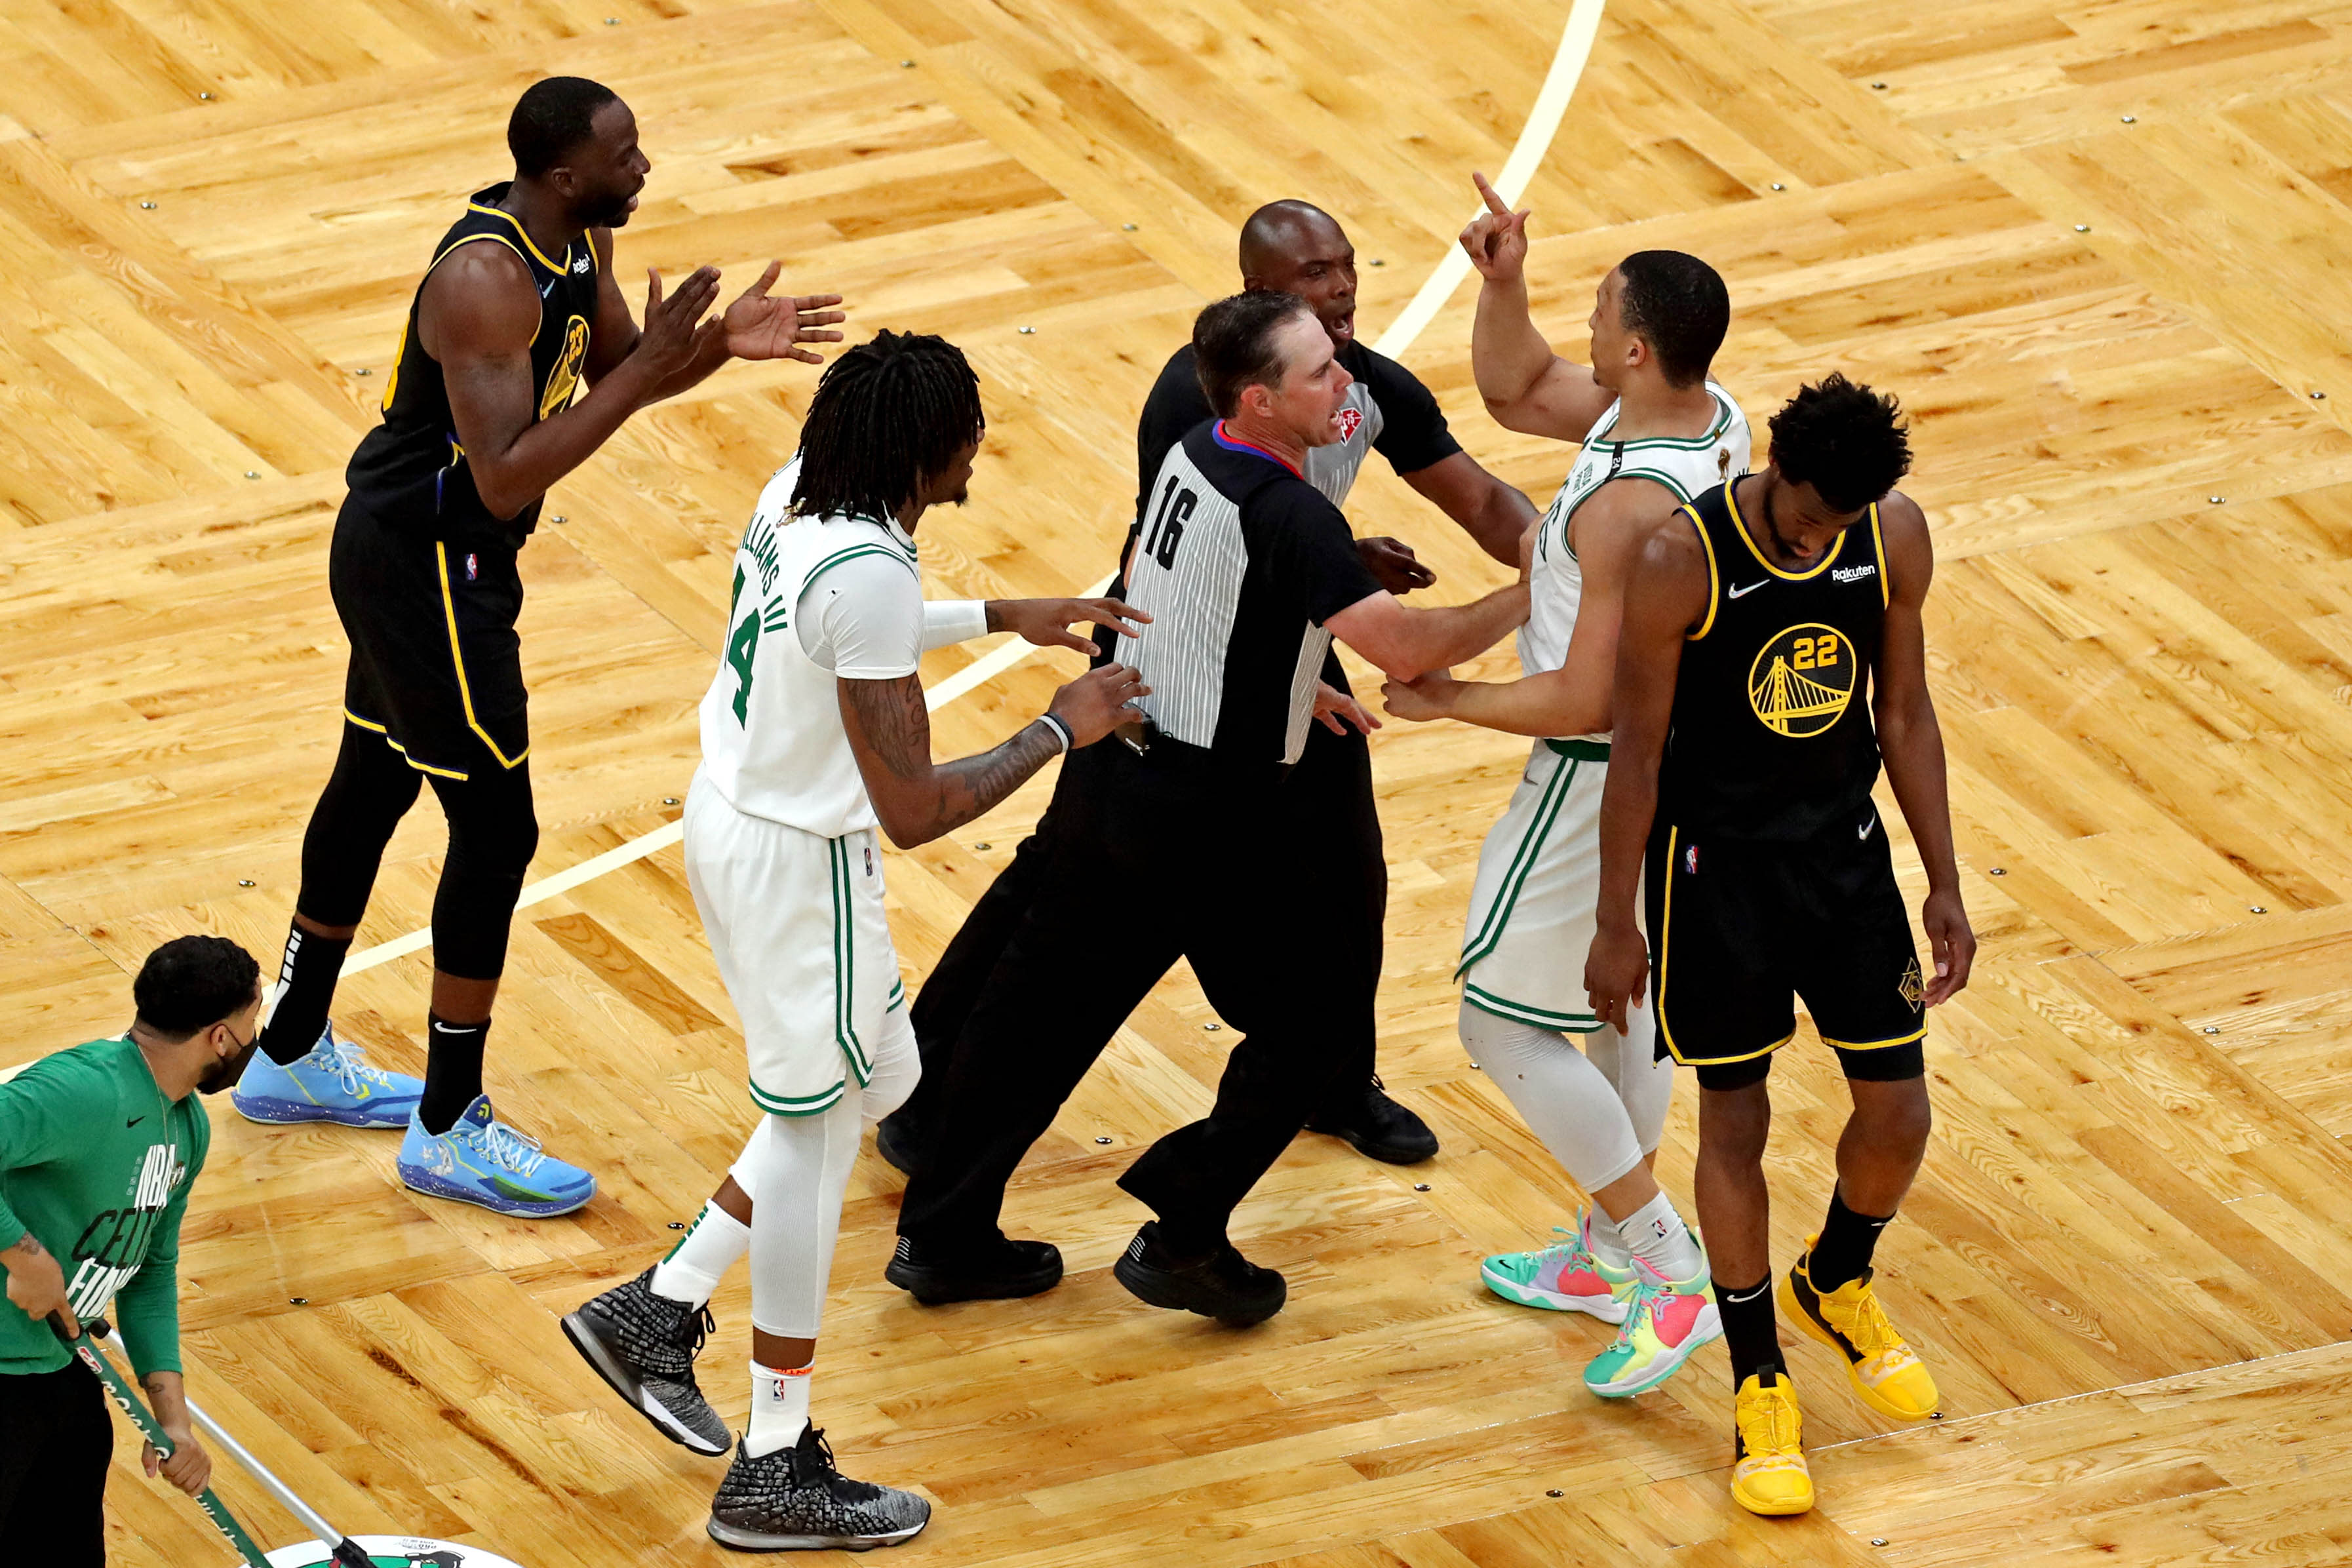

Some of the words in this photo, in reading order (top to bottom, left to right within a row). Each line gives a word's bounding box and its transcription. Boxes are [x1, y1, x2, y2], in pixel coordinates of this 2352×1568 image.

[568, 323, 583, 363] 23
[1613, 457, 1621, 469] 24
[1145, 475, 1198, 571] 16
[1832, 564, 1875, 581] Rakuten
[1793, 635, 1837, 670] 22
[134, 1144, 176, 1211] NBA
